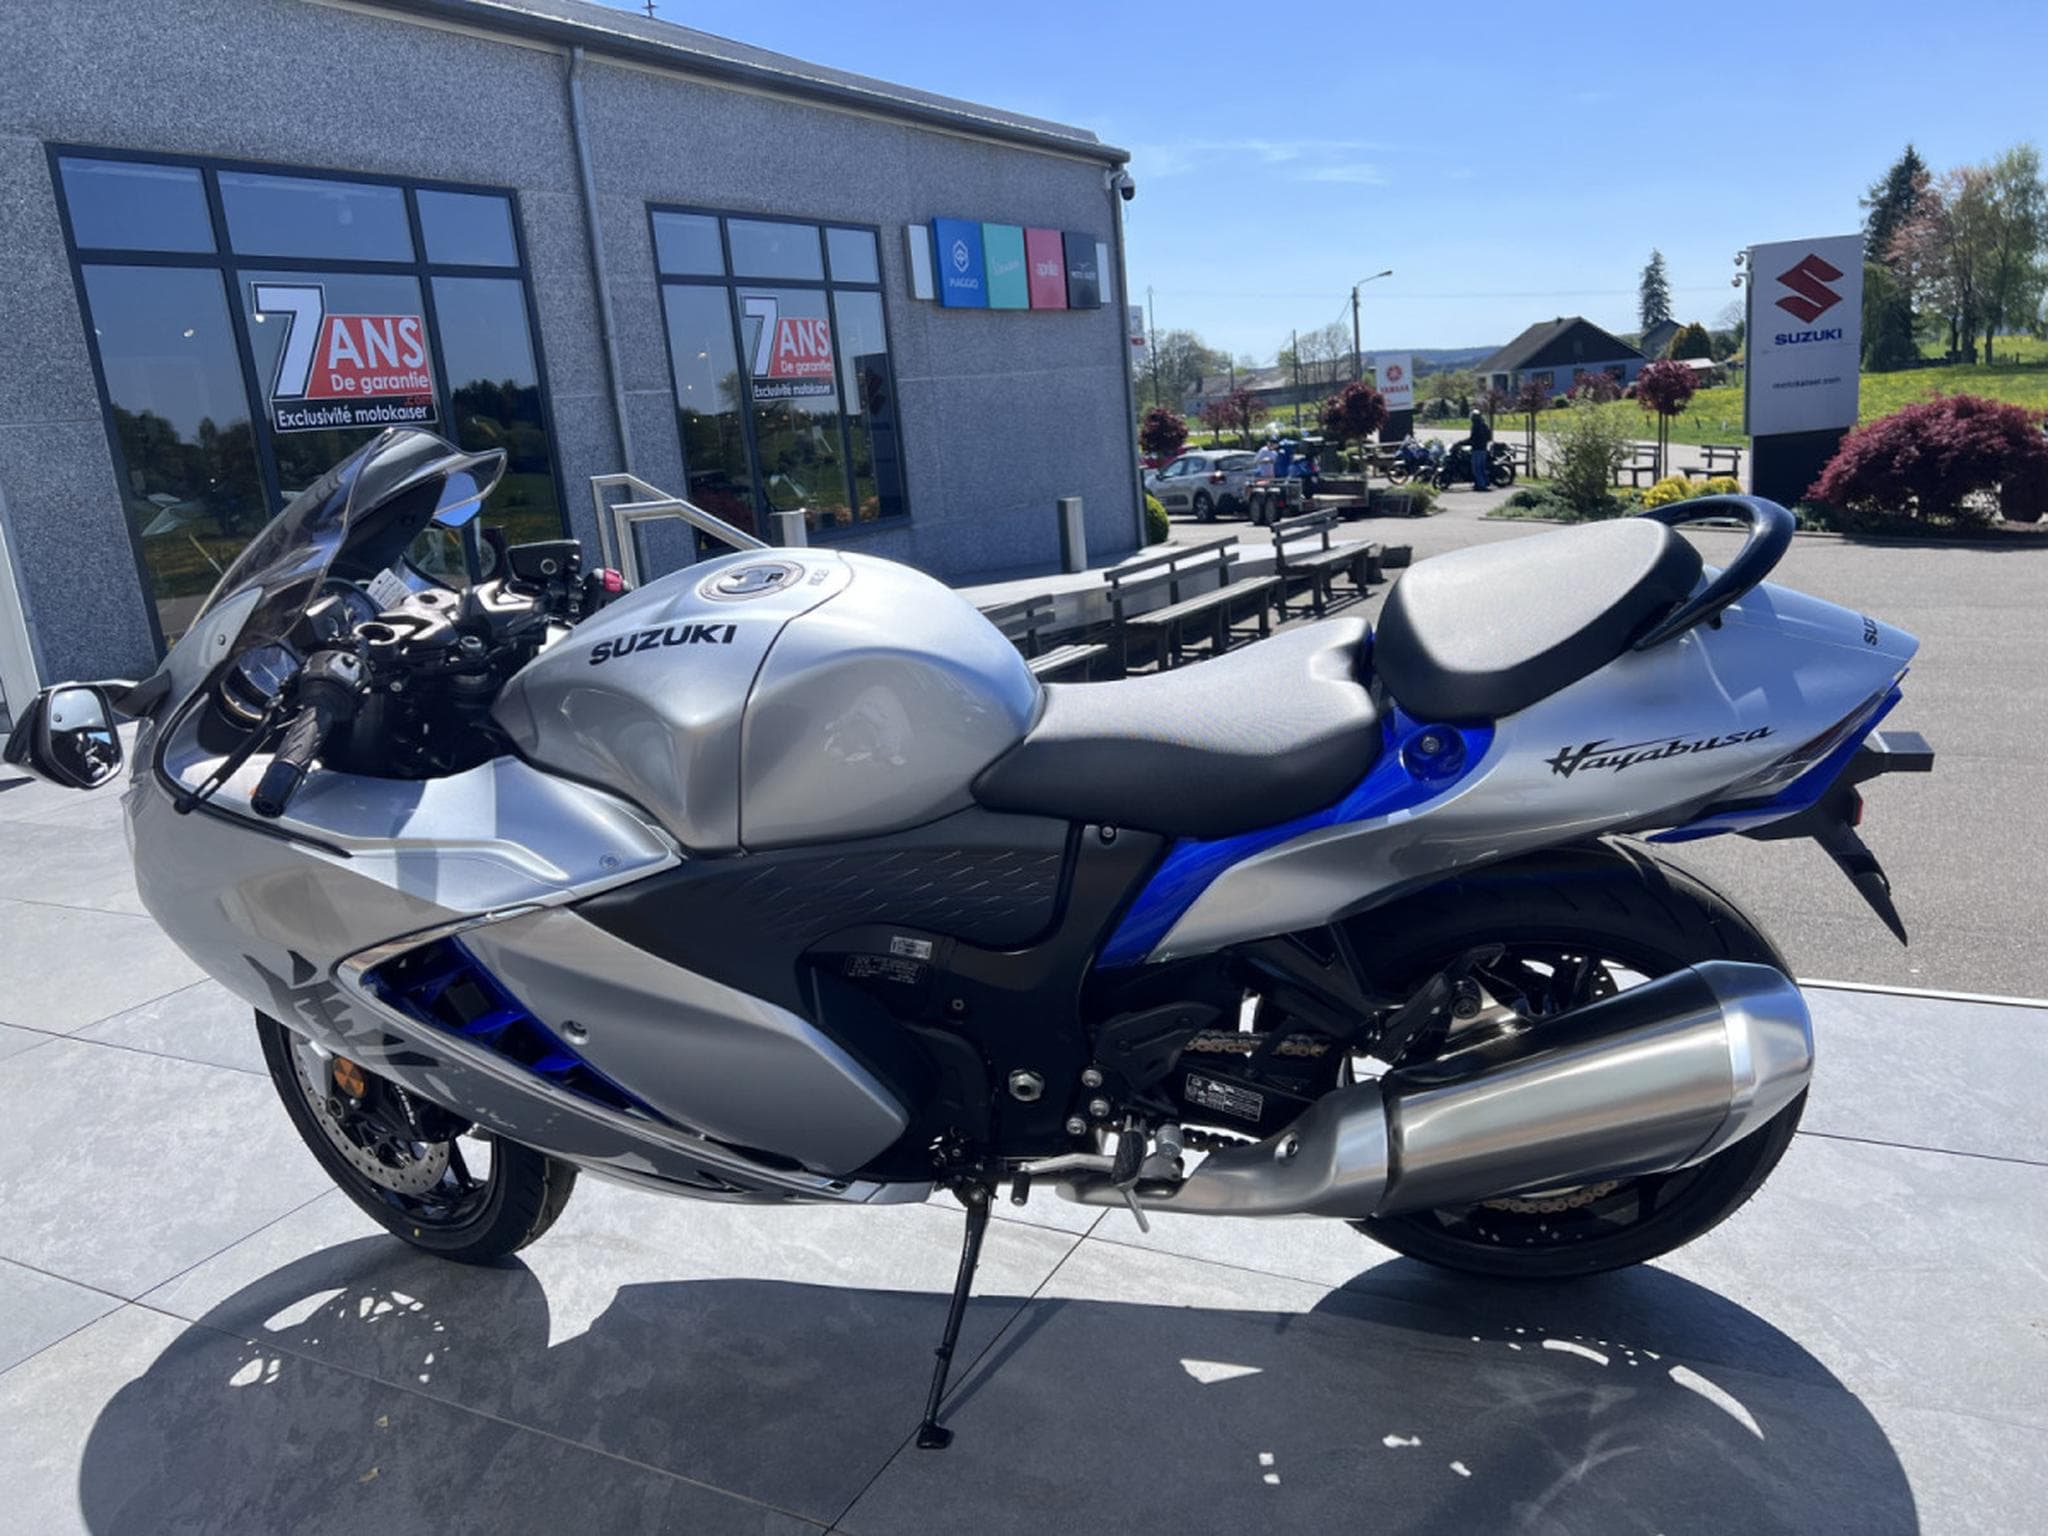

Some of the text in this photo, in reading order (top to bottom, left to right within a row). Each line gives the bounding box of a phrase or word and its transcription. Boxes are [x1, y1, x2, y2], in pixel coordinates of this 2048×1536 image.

[254, 284, 424, 398] 7 ANS
[743, 296, 831, 377] 7 ANS
[1774, 328, 1842, 346] SUZUKI
[331, 371, 430, 394] De garantie
[278, 405, 428, 427] Exclusivité motokaiser
[589, 624, 737, 666] SUZUKI
[1545, 725, 1776, 779] Hayabusa
